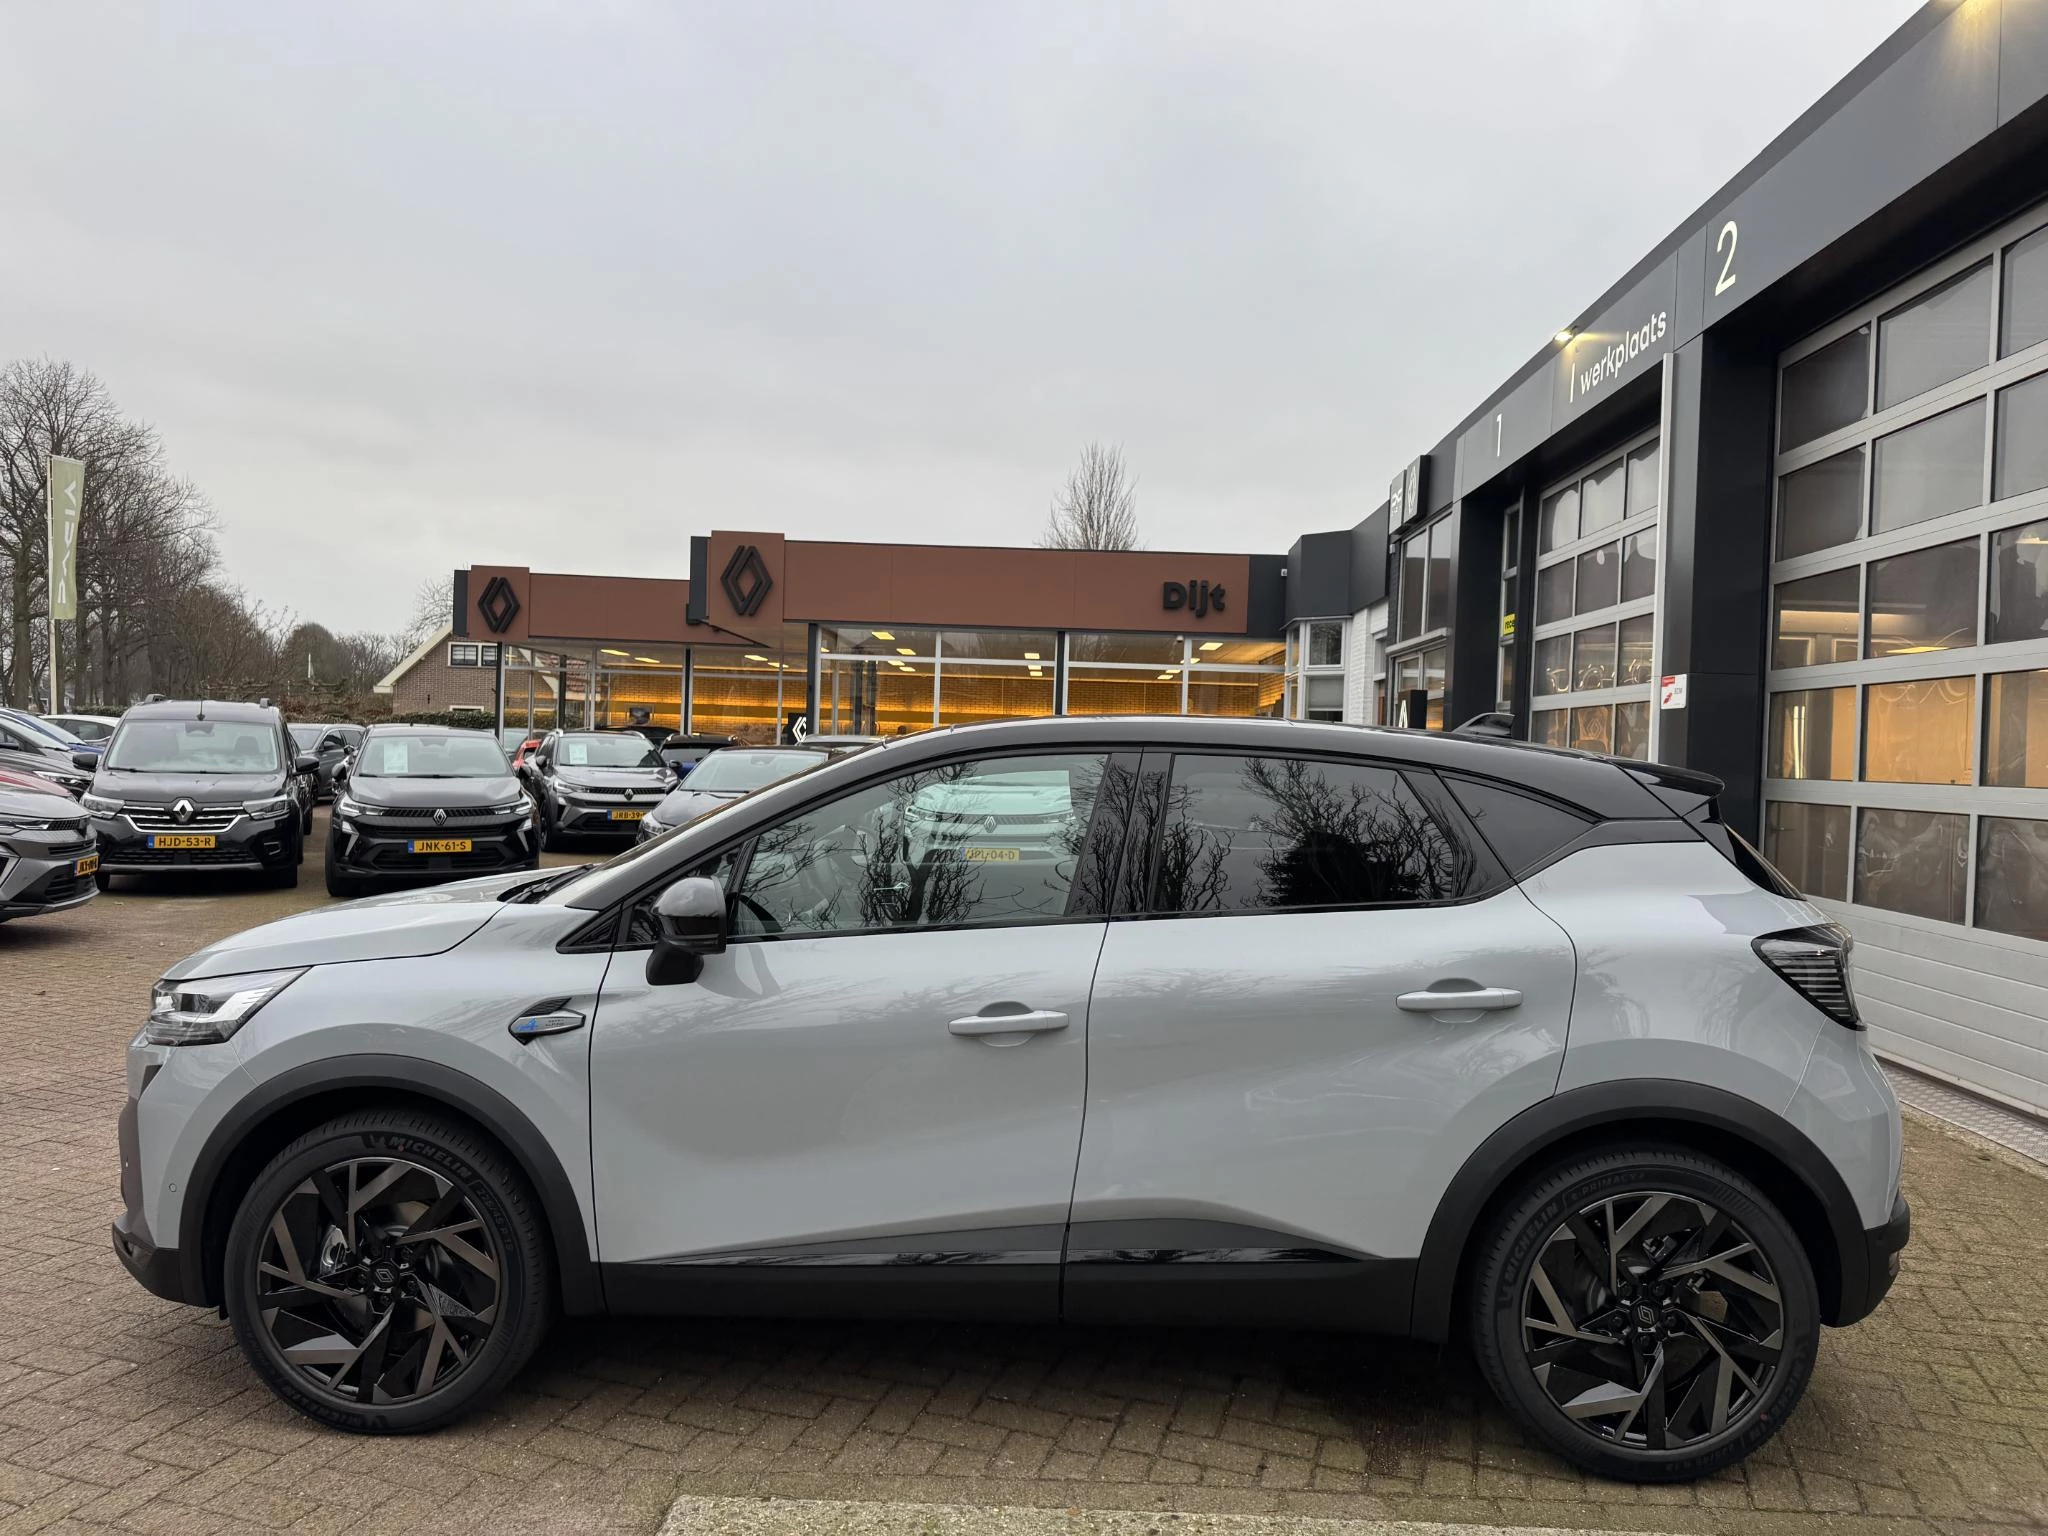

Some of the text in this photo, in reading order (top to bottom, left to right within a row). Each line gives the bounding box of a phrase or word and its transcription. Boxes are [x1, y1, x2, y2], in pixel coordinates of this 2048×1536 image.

[1714, 220, 1738, 297] 2
[1580, 310, 1667, 396] werkplaats
[1496, 413, 1503, 457] 1
[1163, 579, 1226, 618] Dijt
[158, 834, 212, 847] HJD-53-R
[418, 841, 467, 852] JNK-61-S
[968, 849, 1016, 860] JPL-04-D
[388, 1135, 473, 1180] MICHELIN
[1503, 1202, 1559, 1284] MICHELIN
